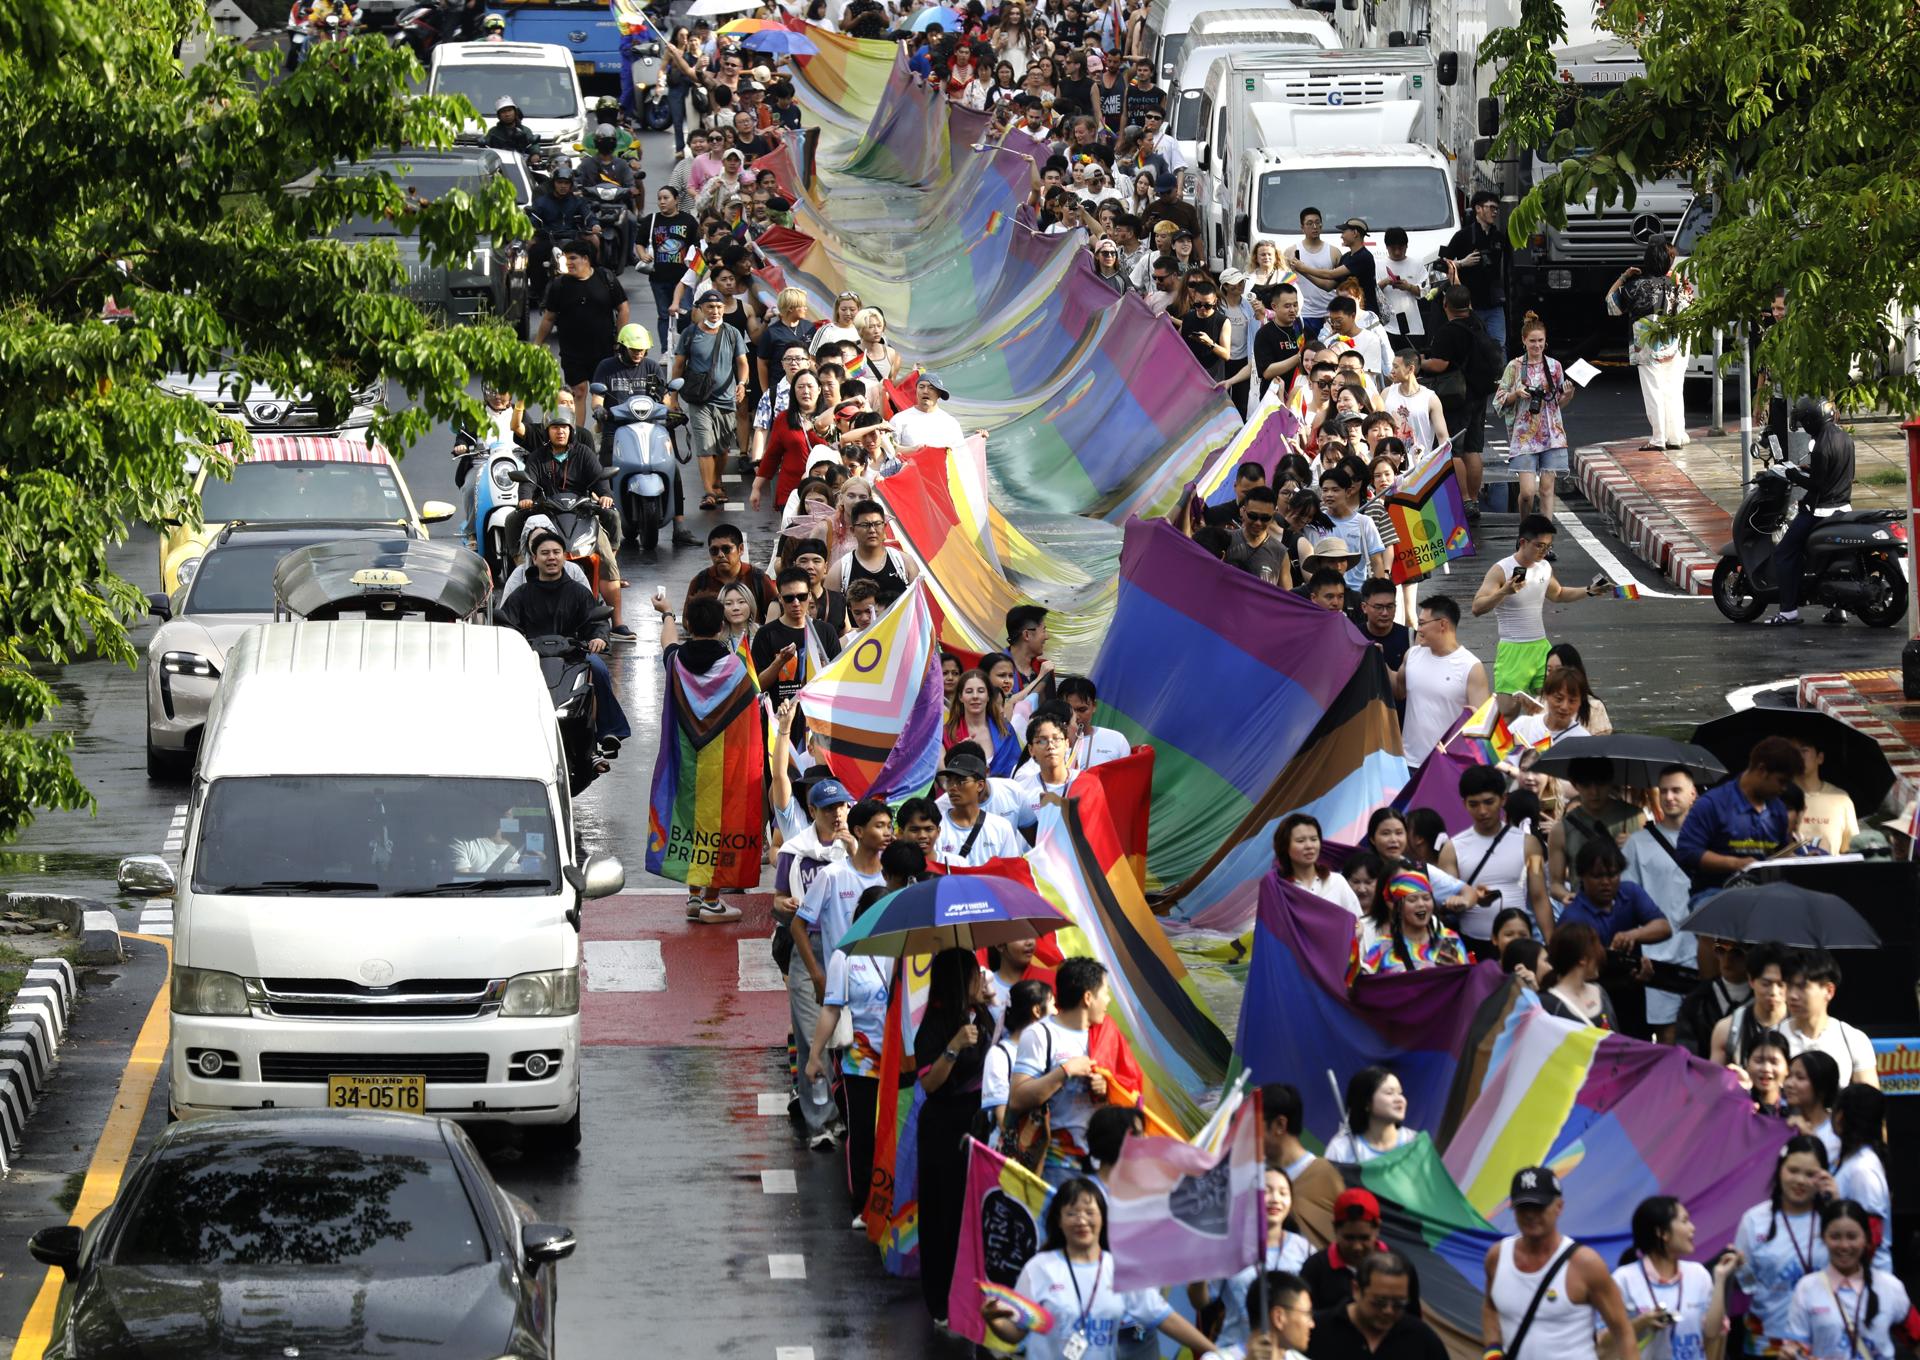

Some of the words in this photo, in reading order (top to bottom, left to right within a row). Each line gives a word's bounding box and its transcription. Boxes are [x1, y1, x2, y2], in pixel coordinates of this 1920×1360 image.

[1328, 92, 1342, 106] G
[671, 825, 759, 850] BANGKOK
[667, 843, 720, 866] PRIDE
[335, 1086, 419, 1108] 34-0516
